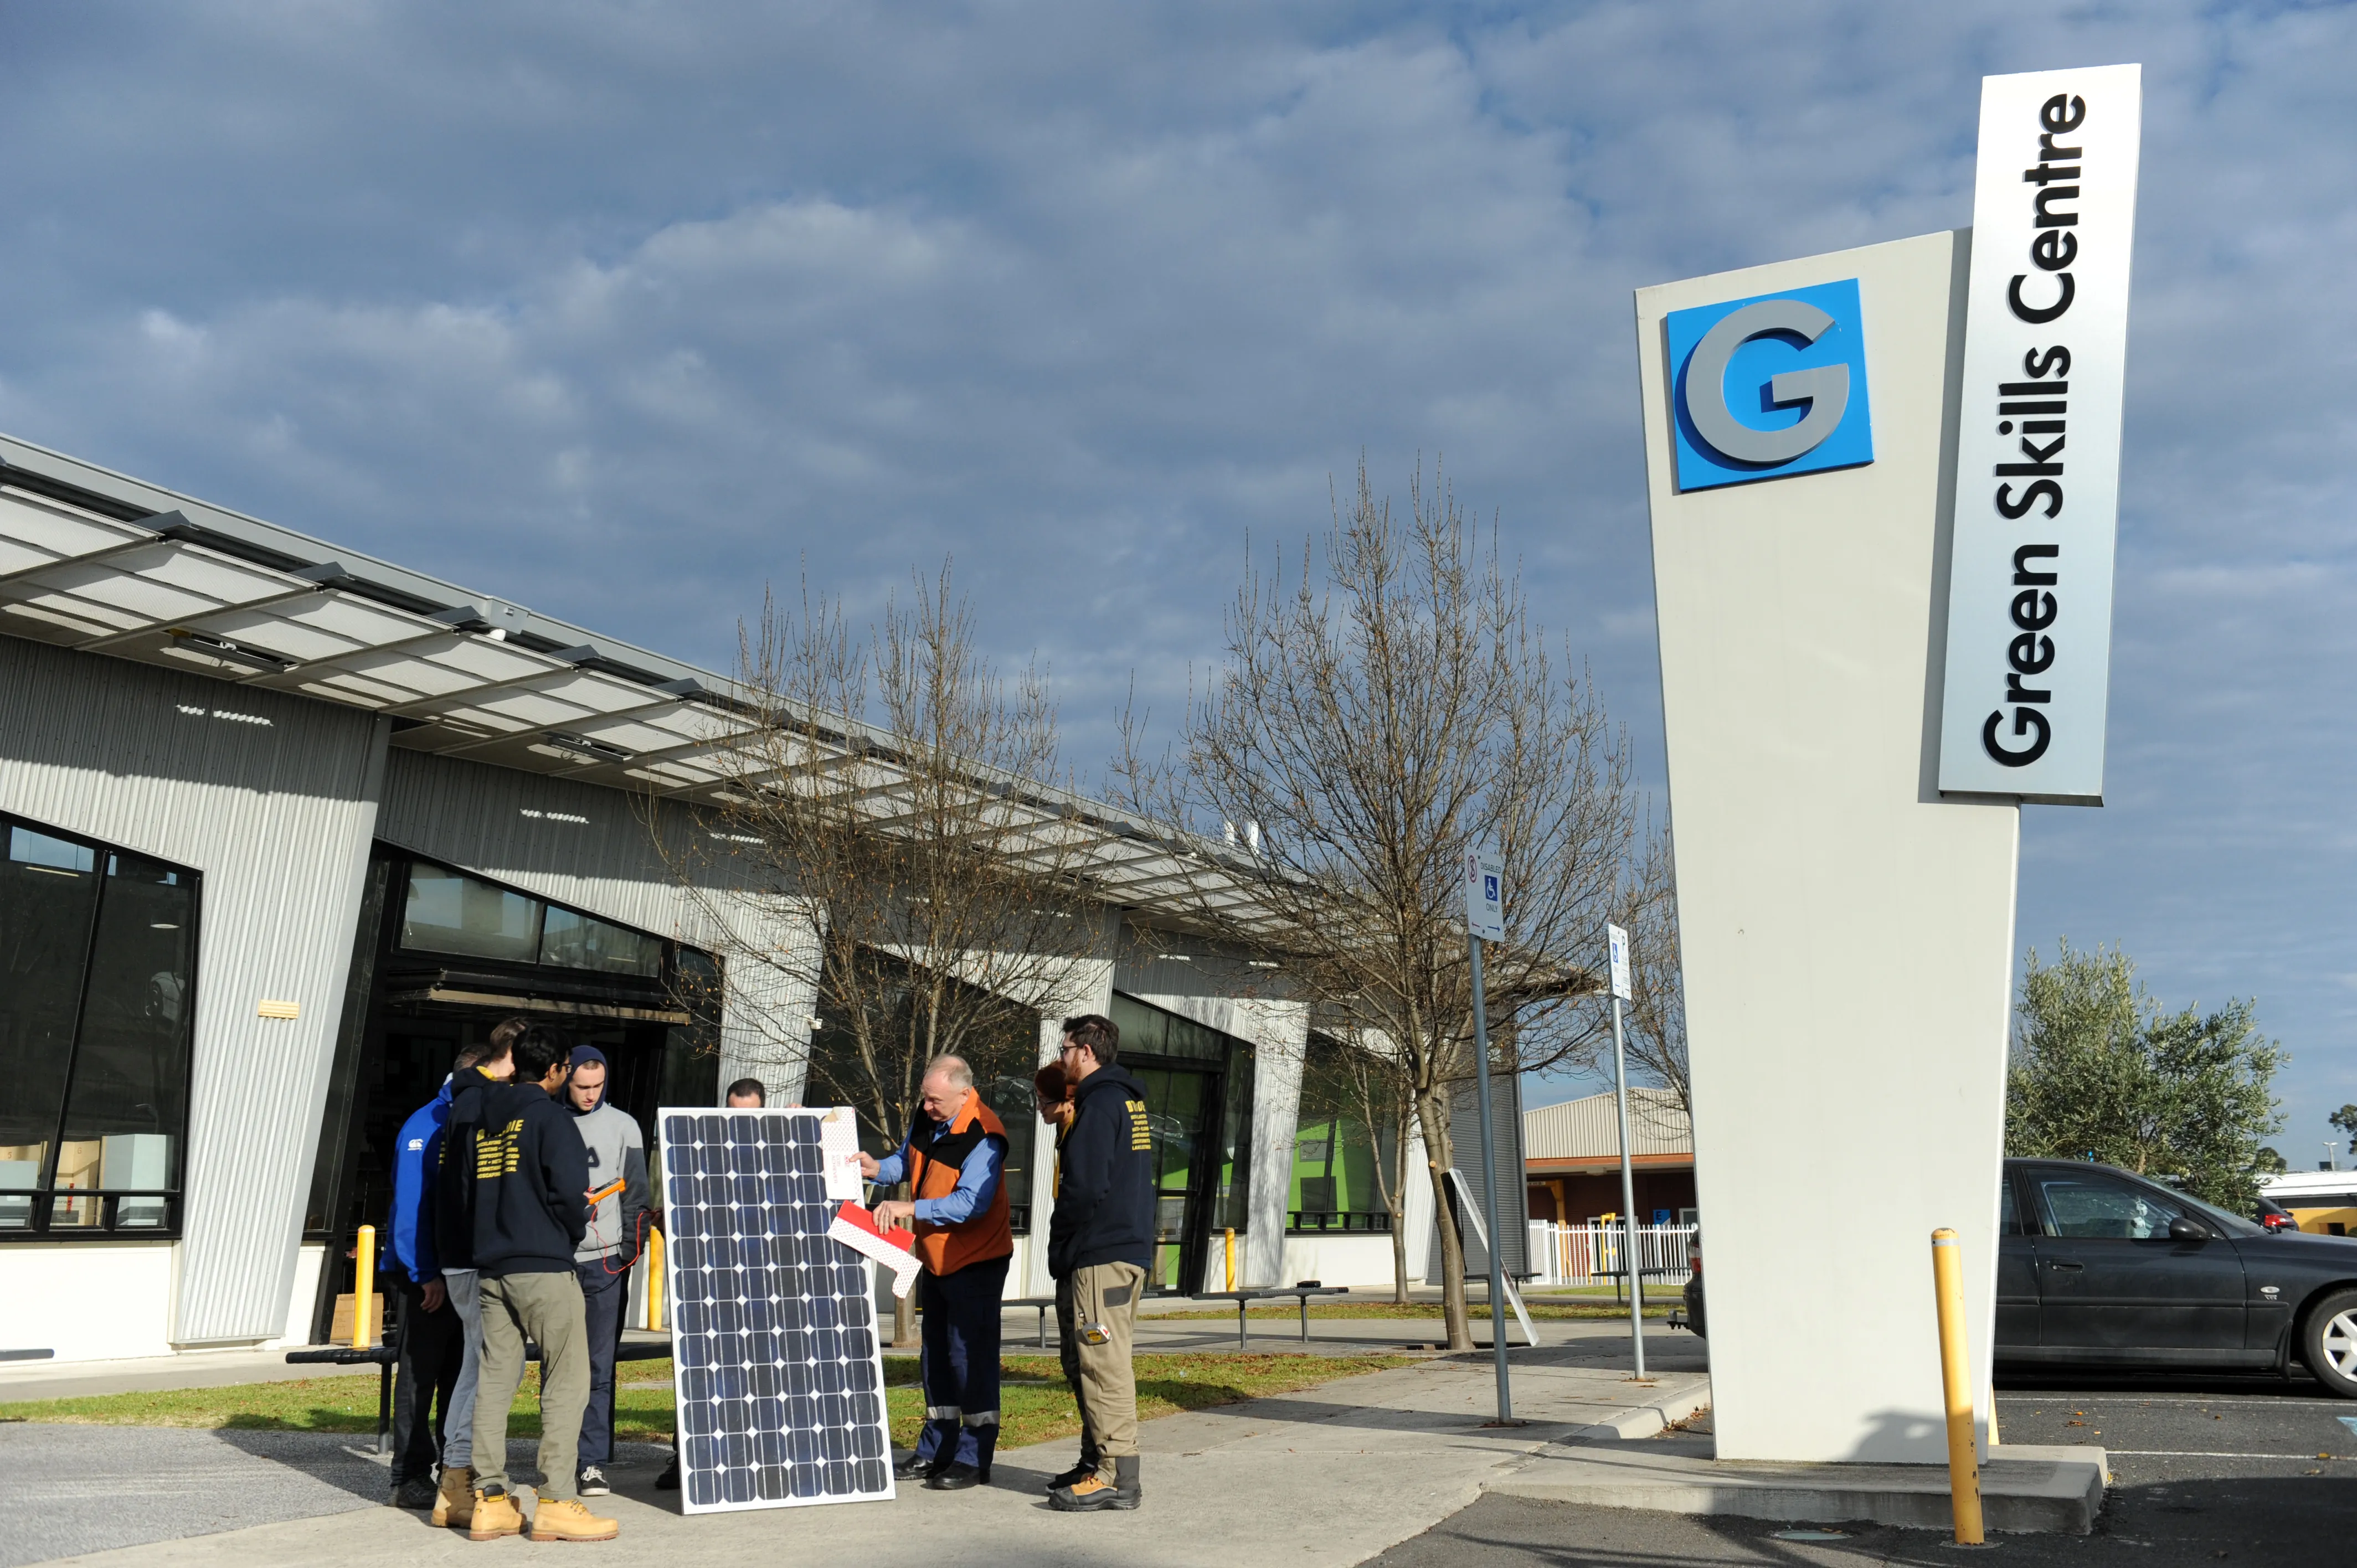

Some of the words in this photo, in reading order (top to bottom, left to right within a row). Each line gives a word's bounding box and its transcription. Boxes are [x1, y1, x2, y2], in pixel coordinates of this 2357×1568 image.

[2008, 94, 2086, 324] Centre
[1686, 300, 1849, 463] G
[1995, 345, 2071, 520] Skills
[1983, 544, 2060, 768] Green
[1480, 862, 1501, 874] DISABLED
[1486, 902, 1498, 912] ONLY
[1622, 935, 1626, 951] P
[1656, 1211, 1662, 1220] E
